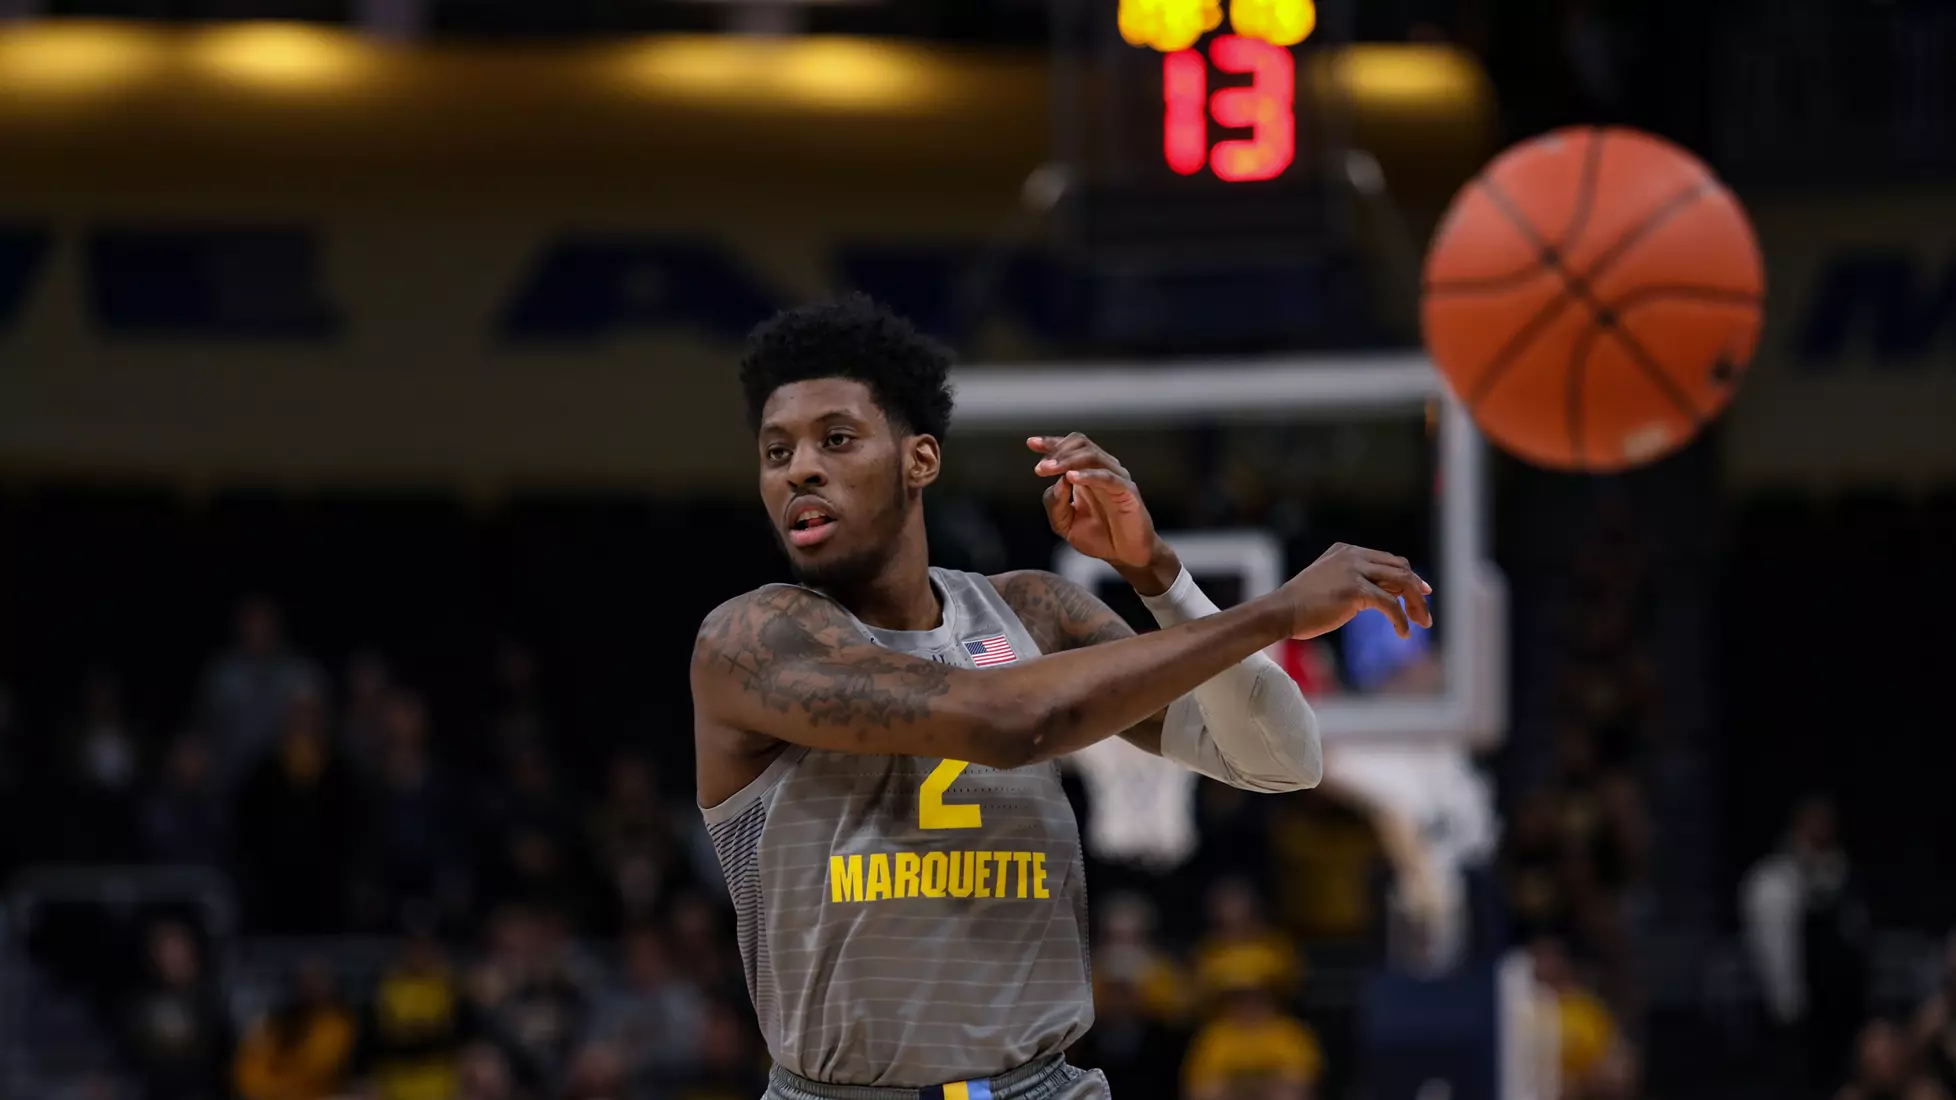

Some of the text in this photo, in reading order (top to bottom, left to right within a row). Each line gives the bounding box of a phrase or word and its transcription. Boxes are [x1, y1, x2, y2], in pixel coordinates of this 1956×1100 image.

[1163, 34, 1295, 182] 13
[918, 757, 983, 830] 2
[830, 850, 1050, 903] MARQUETTE
